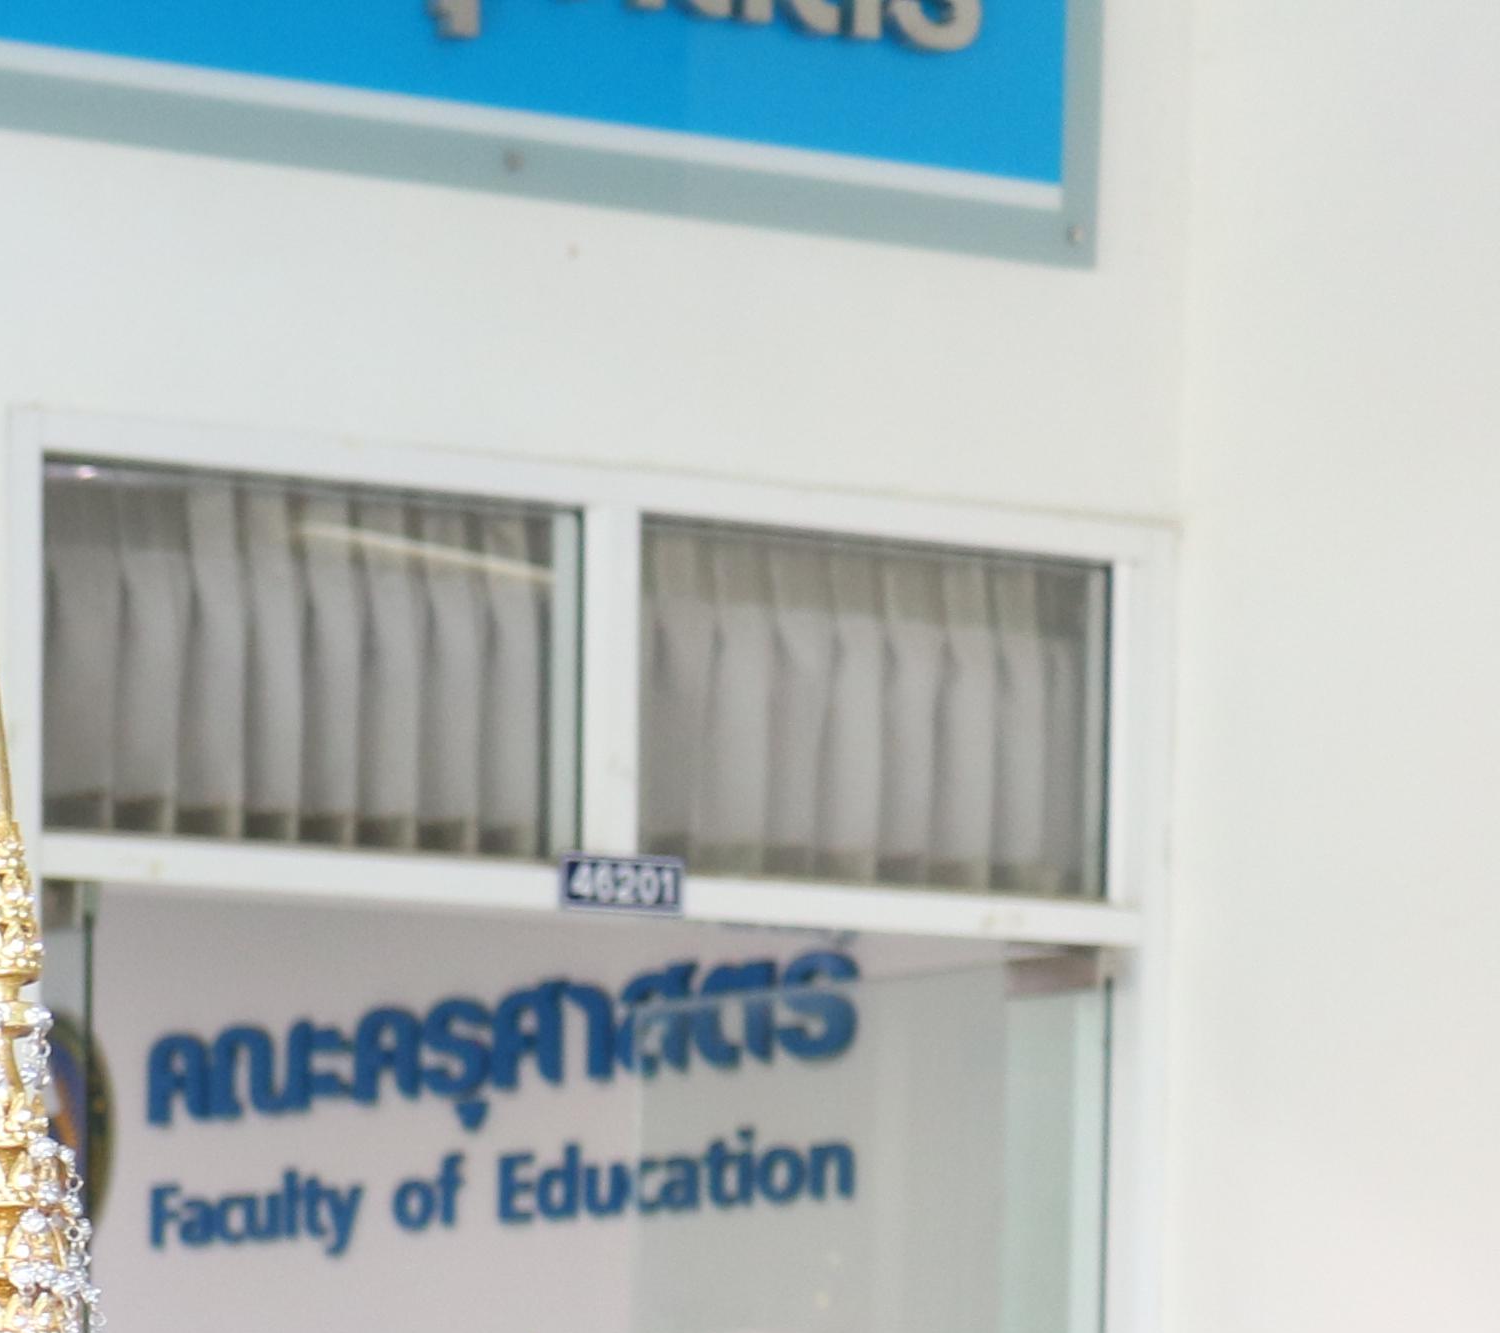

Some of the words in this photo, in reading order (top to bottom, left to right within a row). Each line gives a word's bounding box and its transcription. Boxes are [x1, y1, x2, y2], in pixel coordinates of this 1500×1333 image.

[571, 863, 676, 904] 46201
[147, 951, 859, 1131] คณะครุศาสตร
[149, 1169, 362, 1257] Faculty
[394, 1152, 464, 1231] of
[498, 1128, 855, 1224] Education
